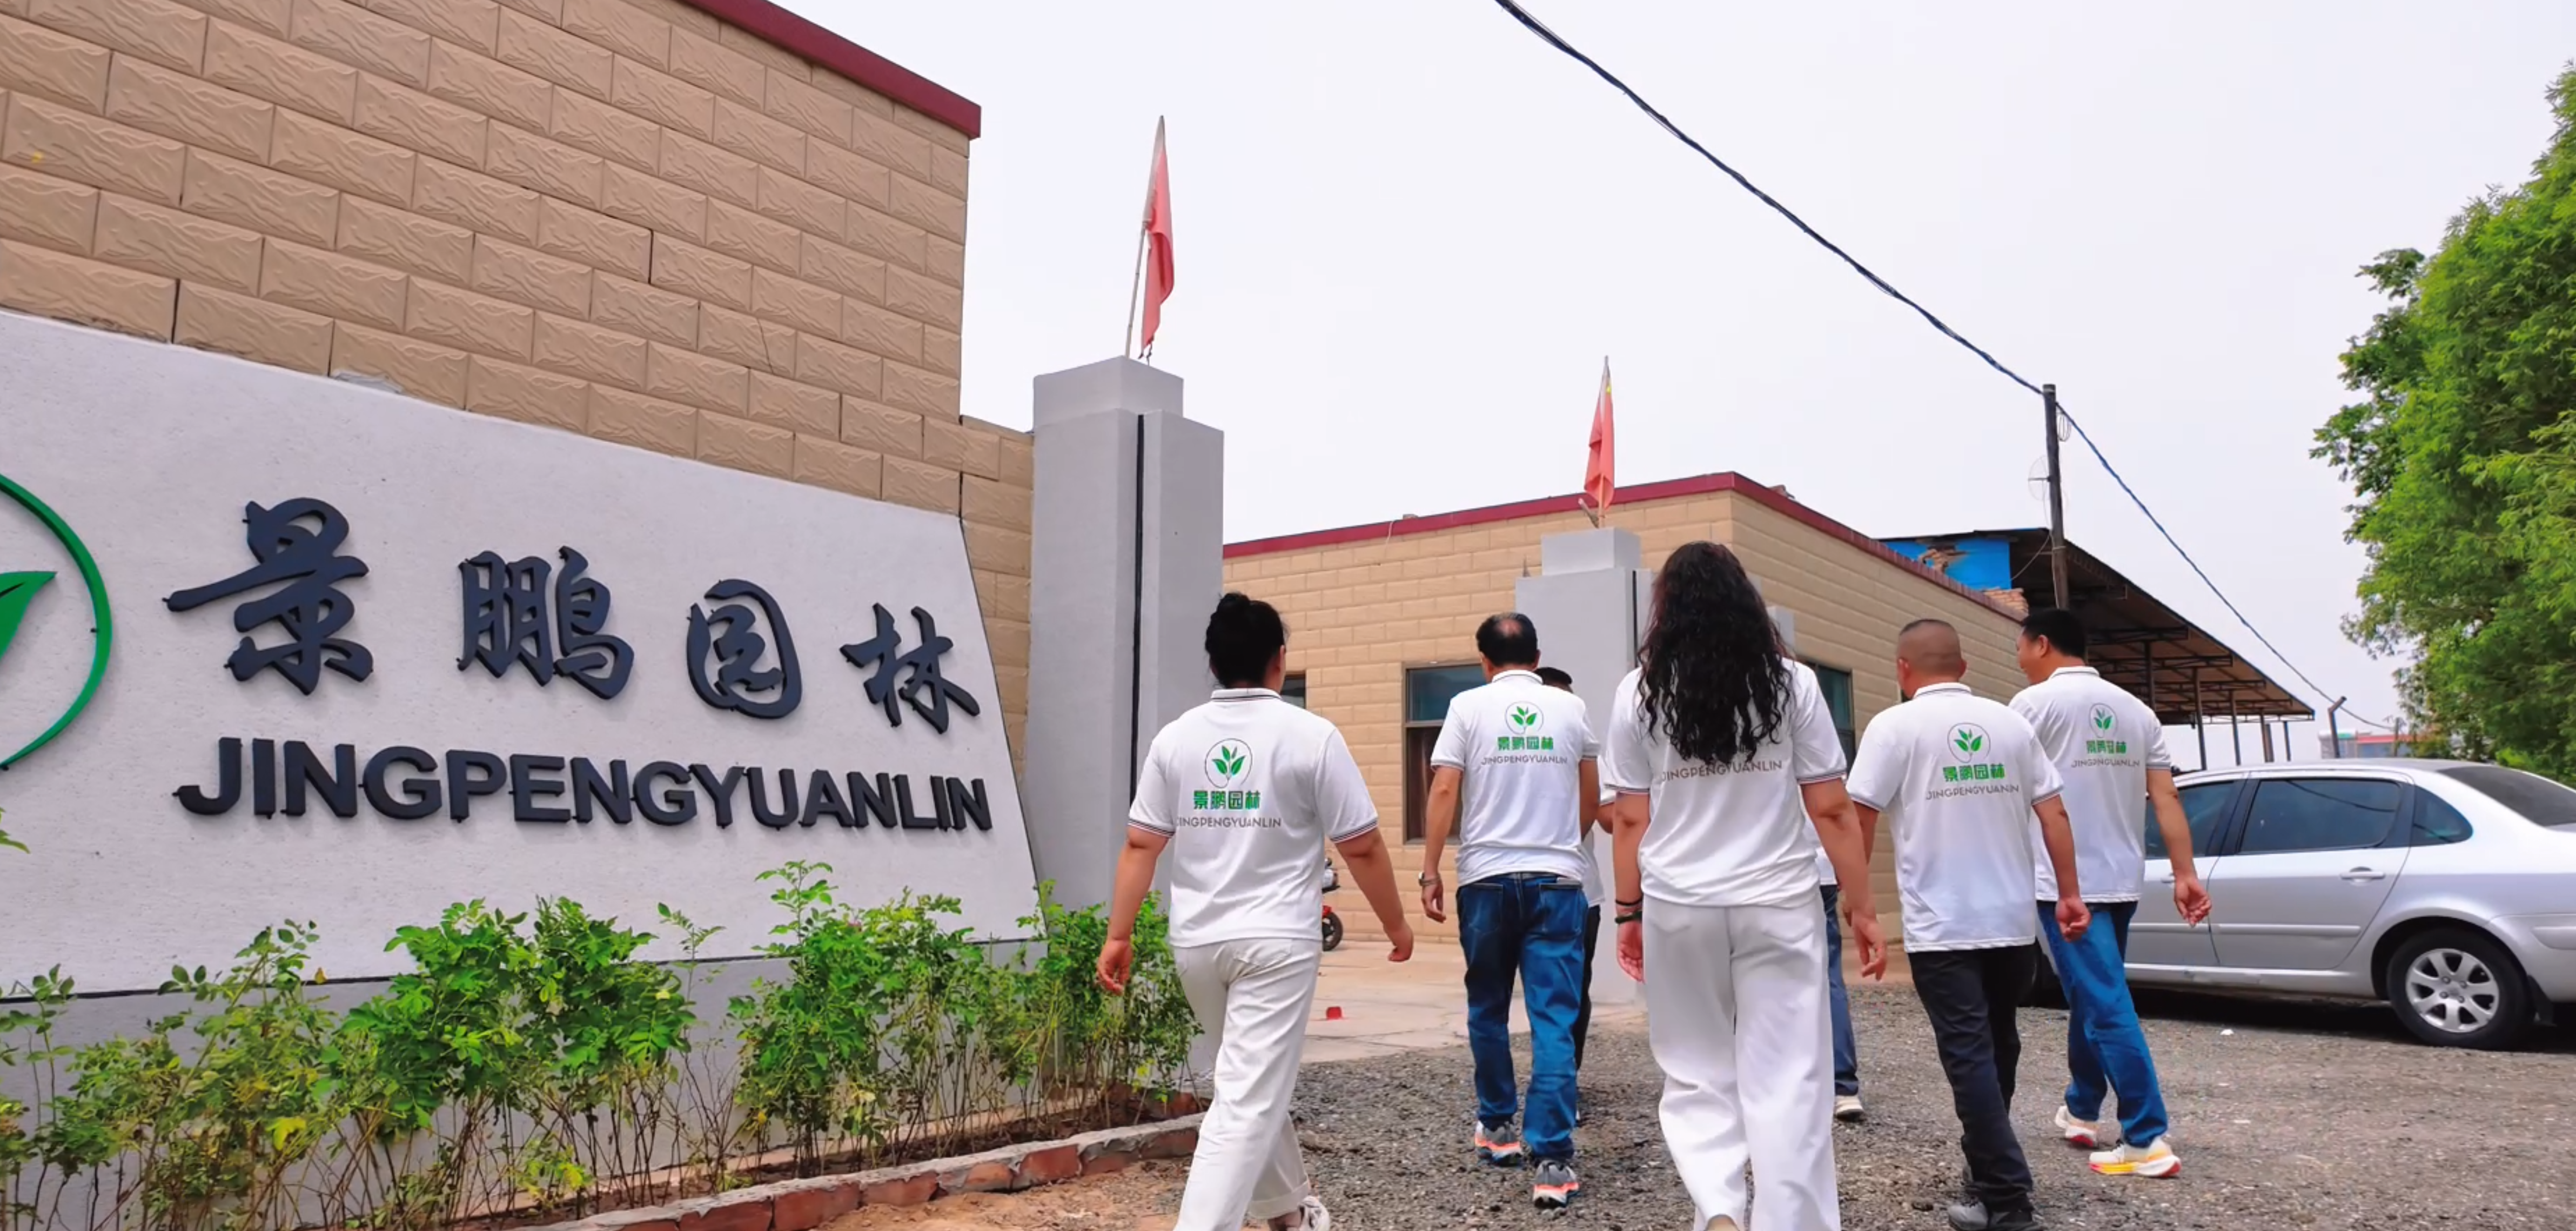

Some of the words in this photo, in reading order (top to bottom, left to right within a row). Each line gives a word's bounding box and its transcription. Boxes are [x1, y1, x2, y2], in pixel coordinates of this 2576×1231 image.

[163, 497, 980, 734] 景鹏园林
[174, 737, 992, 831] JINGPENGYUANLIN
[1193, 790, 1261, 810] 景鹏园林
